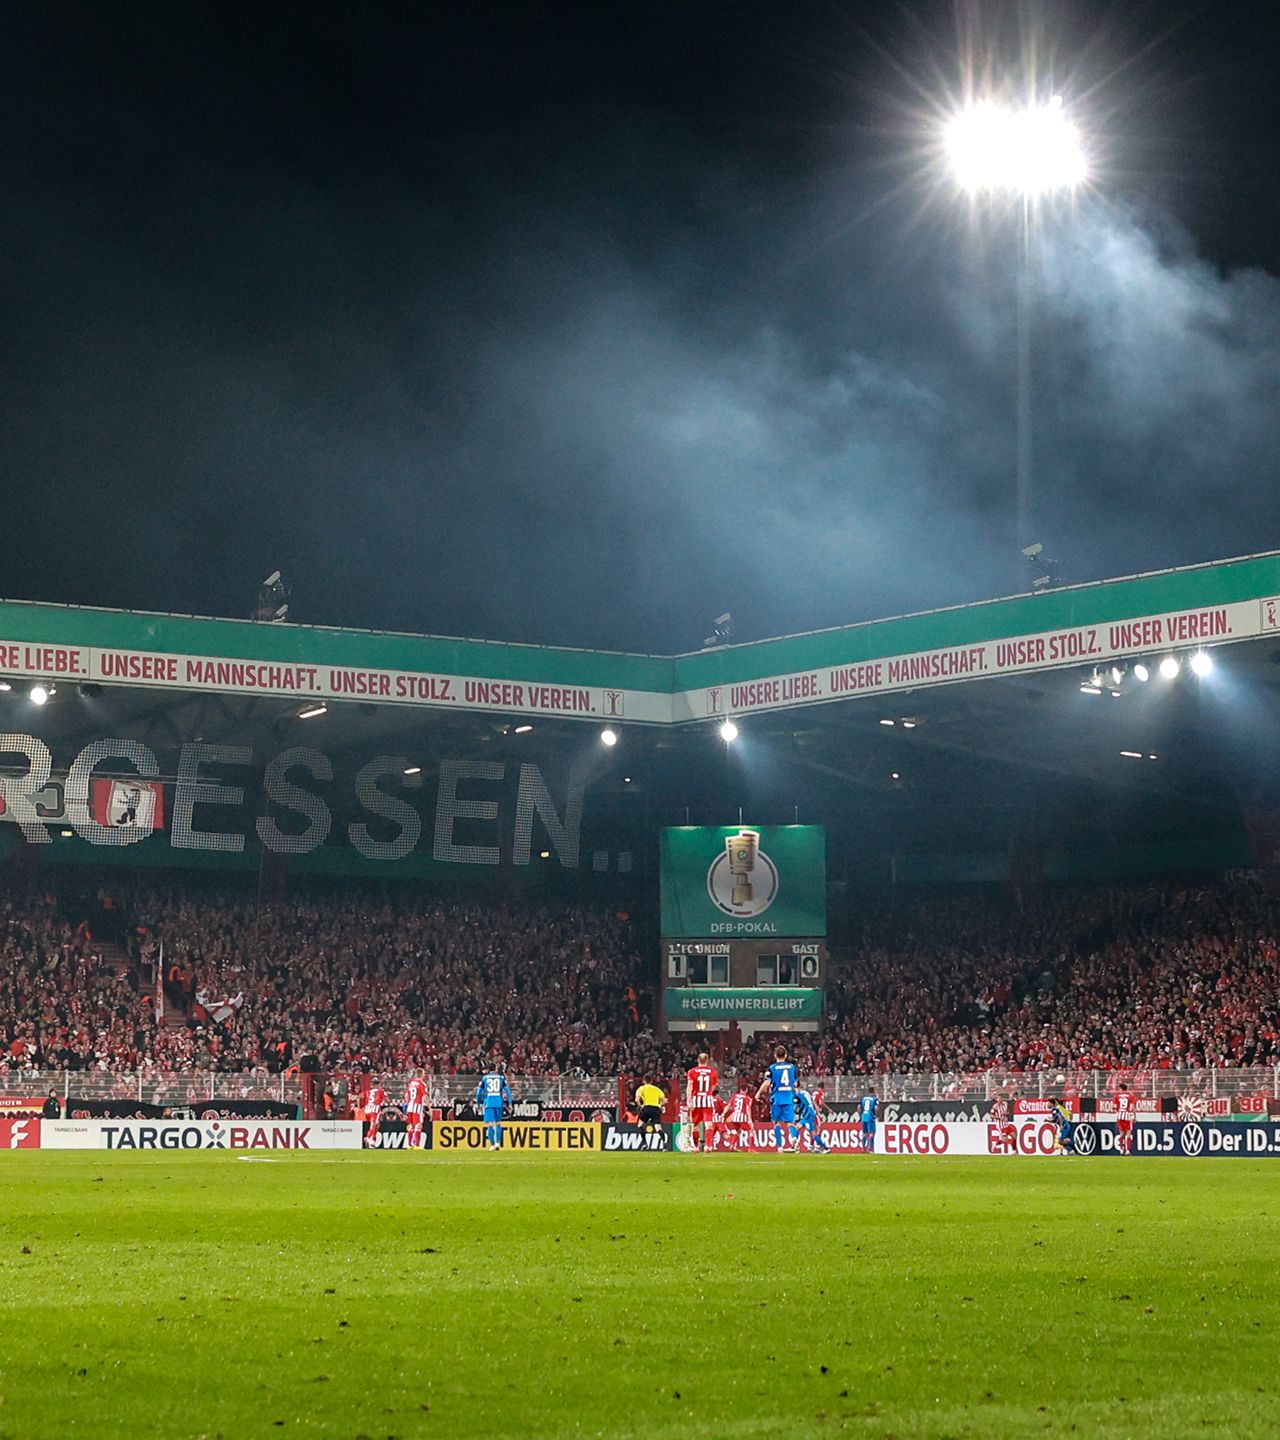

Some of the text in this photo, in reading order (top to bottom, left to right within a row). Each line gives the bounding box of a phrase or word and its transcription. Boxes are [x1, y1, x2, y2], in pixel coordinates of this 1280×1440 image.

[731, 609, 1233, 708] UNSERE LIEBE. UNSERE MANNSCHAFT. UNSER STOLZ. UNSER VEREIN.
[25, 647, 87, 674] LIEBE.
[101, 653, 178, 681] UNSERE
[186, 660, 322, 692] MANNSCHAFT.
[330, 670, 391, 697] UNSER
[396, 676, 456, 702] STOLZ.
[465, 681, 524, 707] UNSER
[528, 686, 596, 713] VEREIN.
[711, 922, 777, 933] DFB-POKAL
[669, 944, 730, 954] 1. FC UNION
[792, 944, 819, 954] GAST
[802, 956, 818, 977] 0
[682, 998, 805, 1010] #GEWINNERBLEIBT
[486, 1079, 500, 1092] 30
[697, 1075, 710, 1092] 11
[780, 1069, 789, 1086] 4
[409, 1087, 417, 1100] 8
[1118, 1098, 1128, 1109] 19
[1239, 1097, 1263, 1112] 98
[884, 1124, 950, 1154] ERGO
[1137, 1129, 1175, 1152] ID.5
[1208, 1129, 1243, 1151] Der
